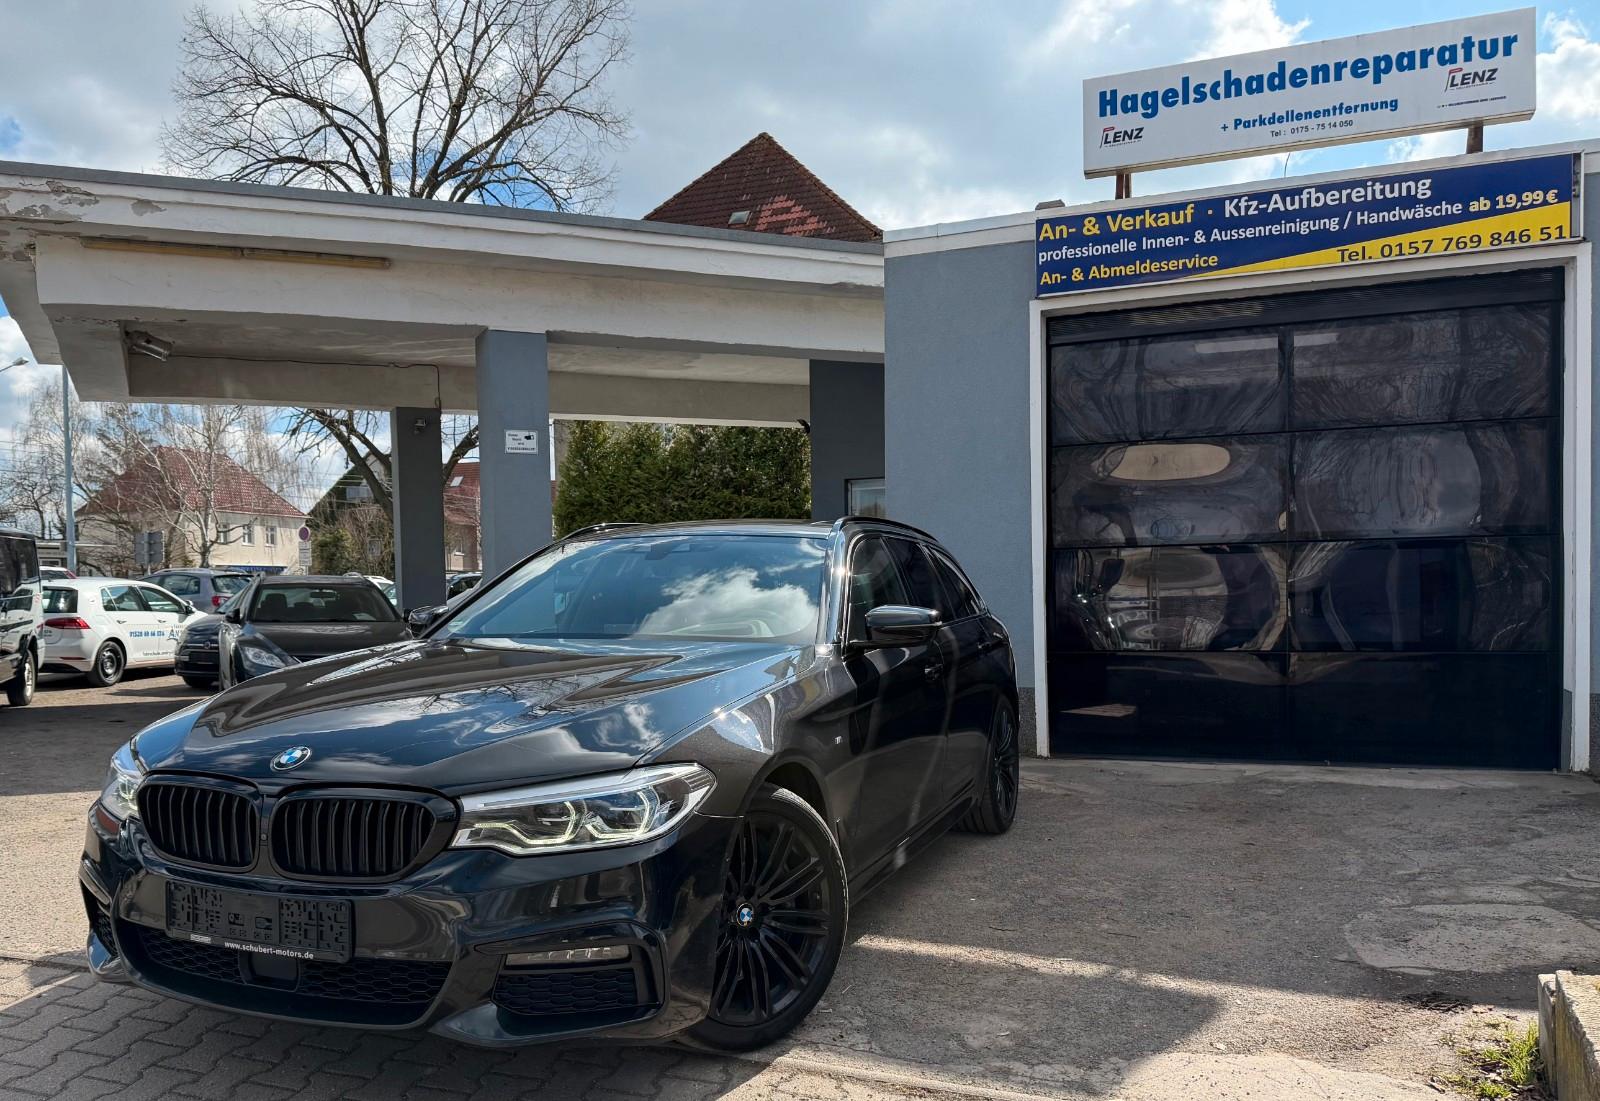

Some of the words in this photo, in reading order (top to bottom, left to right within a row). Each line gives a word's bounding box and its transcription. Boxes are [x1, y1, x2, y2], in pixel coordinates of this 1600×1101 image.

[1098, 34, 1518, 119] Hagelschadenreparatur
[1449, 68, 1498, 88] LENZ
[1233, 98, 1399, 130] Parkdellenentfernung
[1290, 125, 1309, 135] 0175
[1316, 123, 1326, 132] 75
[1328, 121, 1337, 130] 14
[1339, 119, 1354, 129] 050
[1103, 127, 1145, 145] LENZ
[1038, 222, 1076, 242] An-
[1082, 216, 1100, 236] &
[1106, 203, 1195, 232] Verkauf
[1224, 178, 1432, 218] Kfz-Aufbereitung
[1038, 238, 1137, 265] professionelle
[1142, 235, 1190, 250] Innen-
[1194, 229, 1206, 244] &
[1210, 215, 1340, 243] Aussenreinigung
[1356, 201, 1463, 226] Handwäsche
[1468, 196, 1491, 212] ab
[1337, 246, 1373, 263] Tel.
[1380, 239, 1434, 258] 0157
[1441, 233, 1482, 252] 769
[1489, 228, 1531, 247] 846
[1539, 224, 1567, 242] 51
[1039, 271, 1067, 285] An-
[1071, 267, 1085, 281] &
[1088, 253, 1218, 280] Abmeldeservice
[224, 940, 314, 960] www.schubert-motors.de
